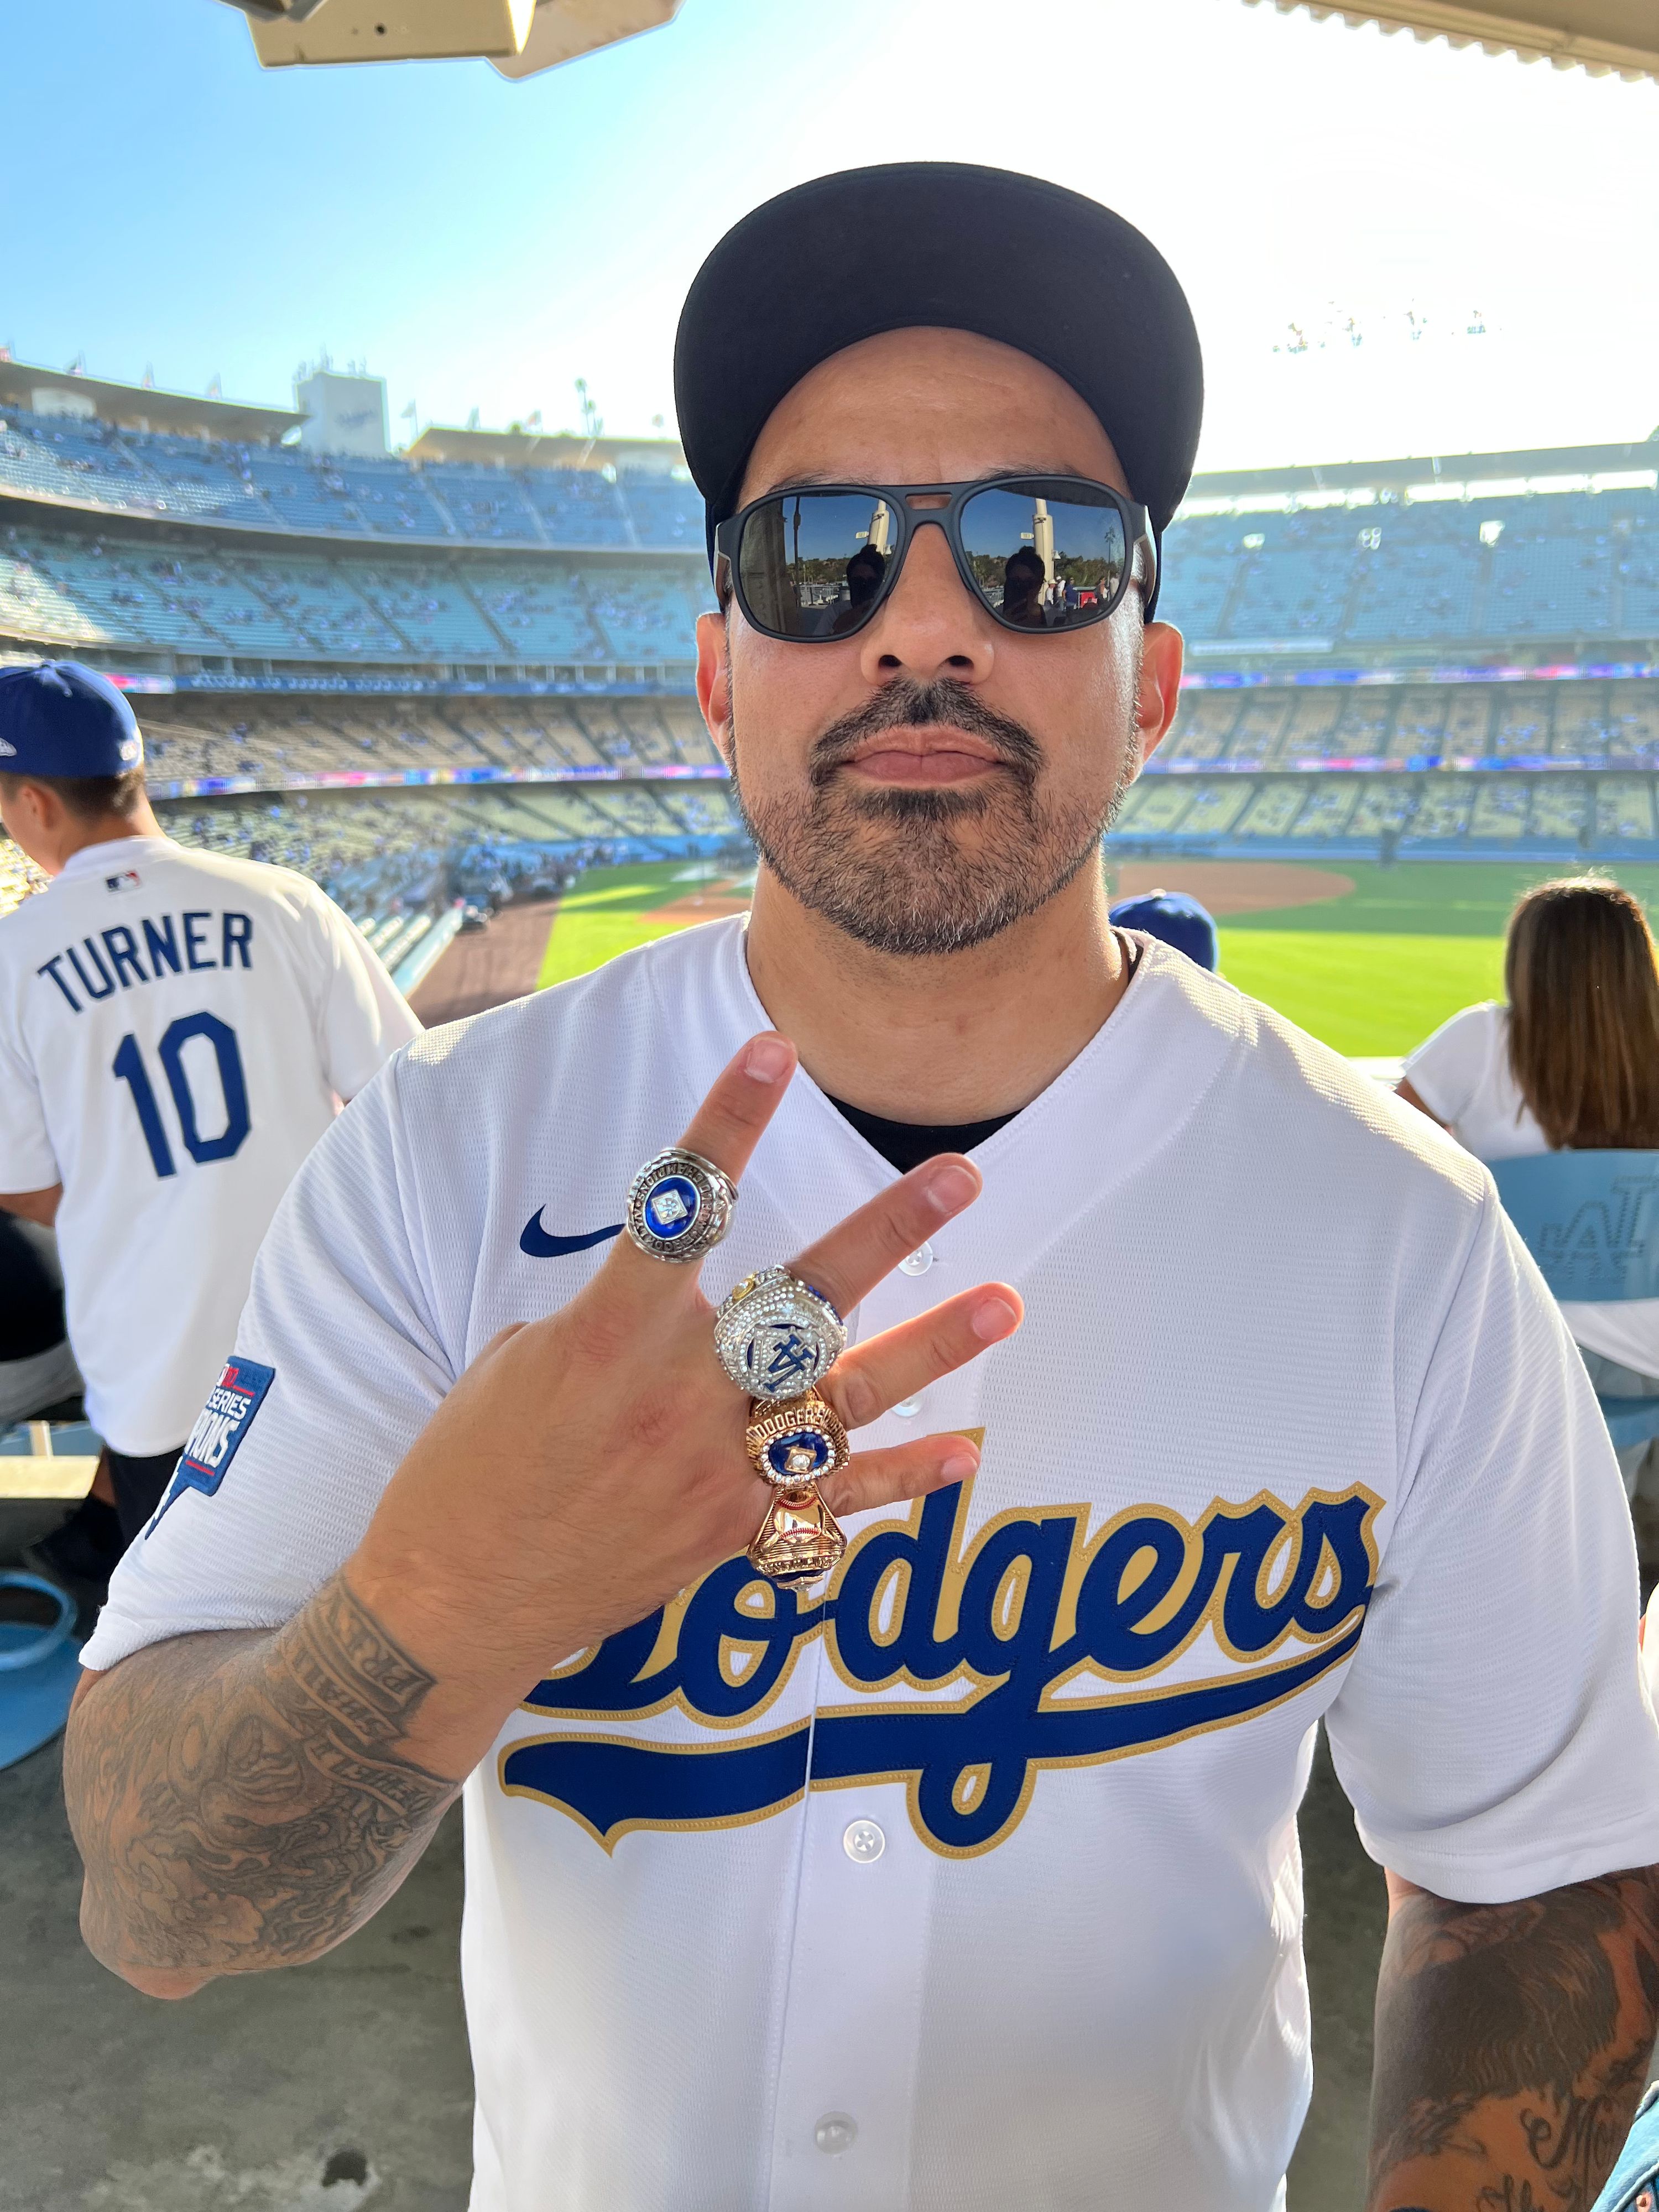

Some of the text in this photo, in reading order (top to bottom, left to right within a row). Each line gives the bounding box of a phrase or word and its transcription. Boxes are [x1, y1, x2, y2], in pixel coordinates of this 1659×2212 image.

[36, 910, 253, 1013] TURNER
[112, 1011, 252, 1177] 10
[637, 1164, 703, 1200] CHAMPIONS
[755, 1407, 826, 1439] DODGERS
